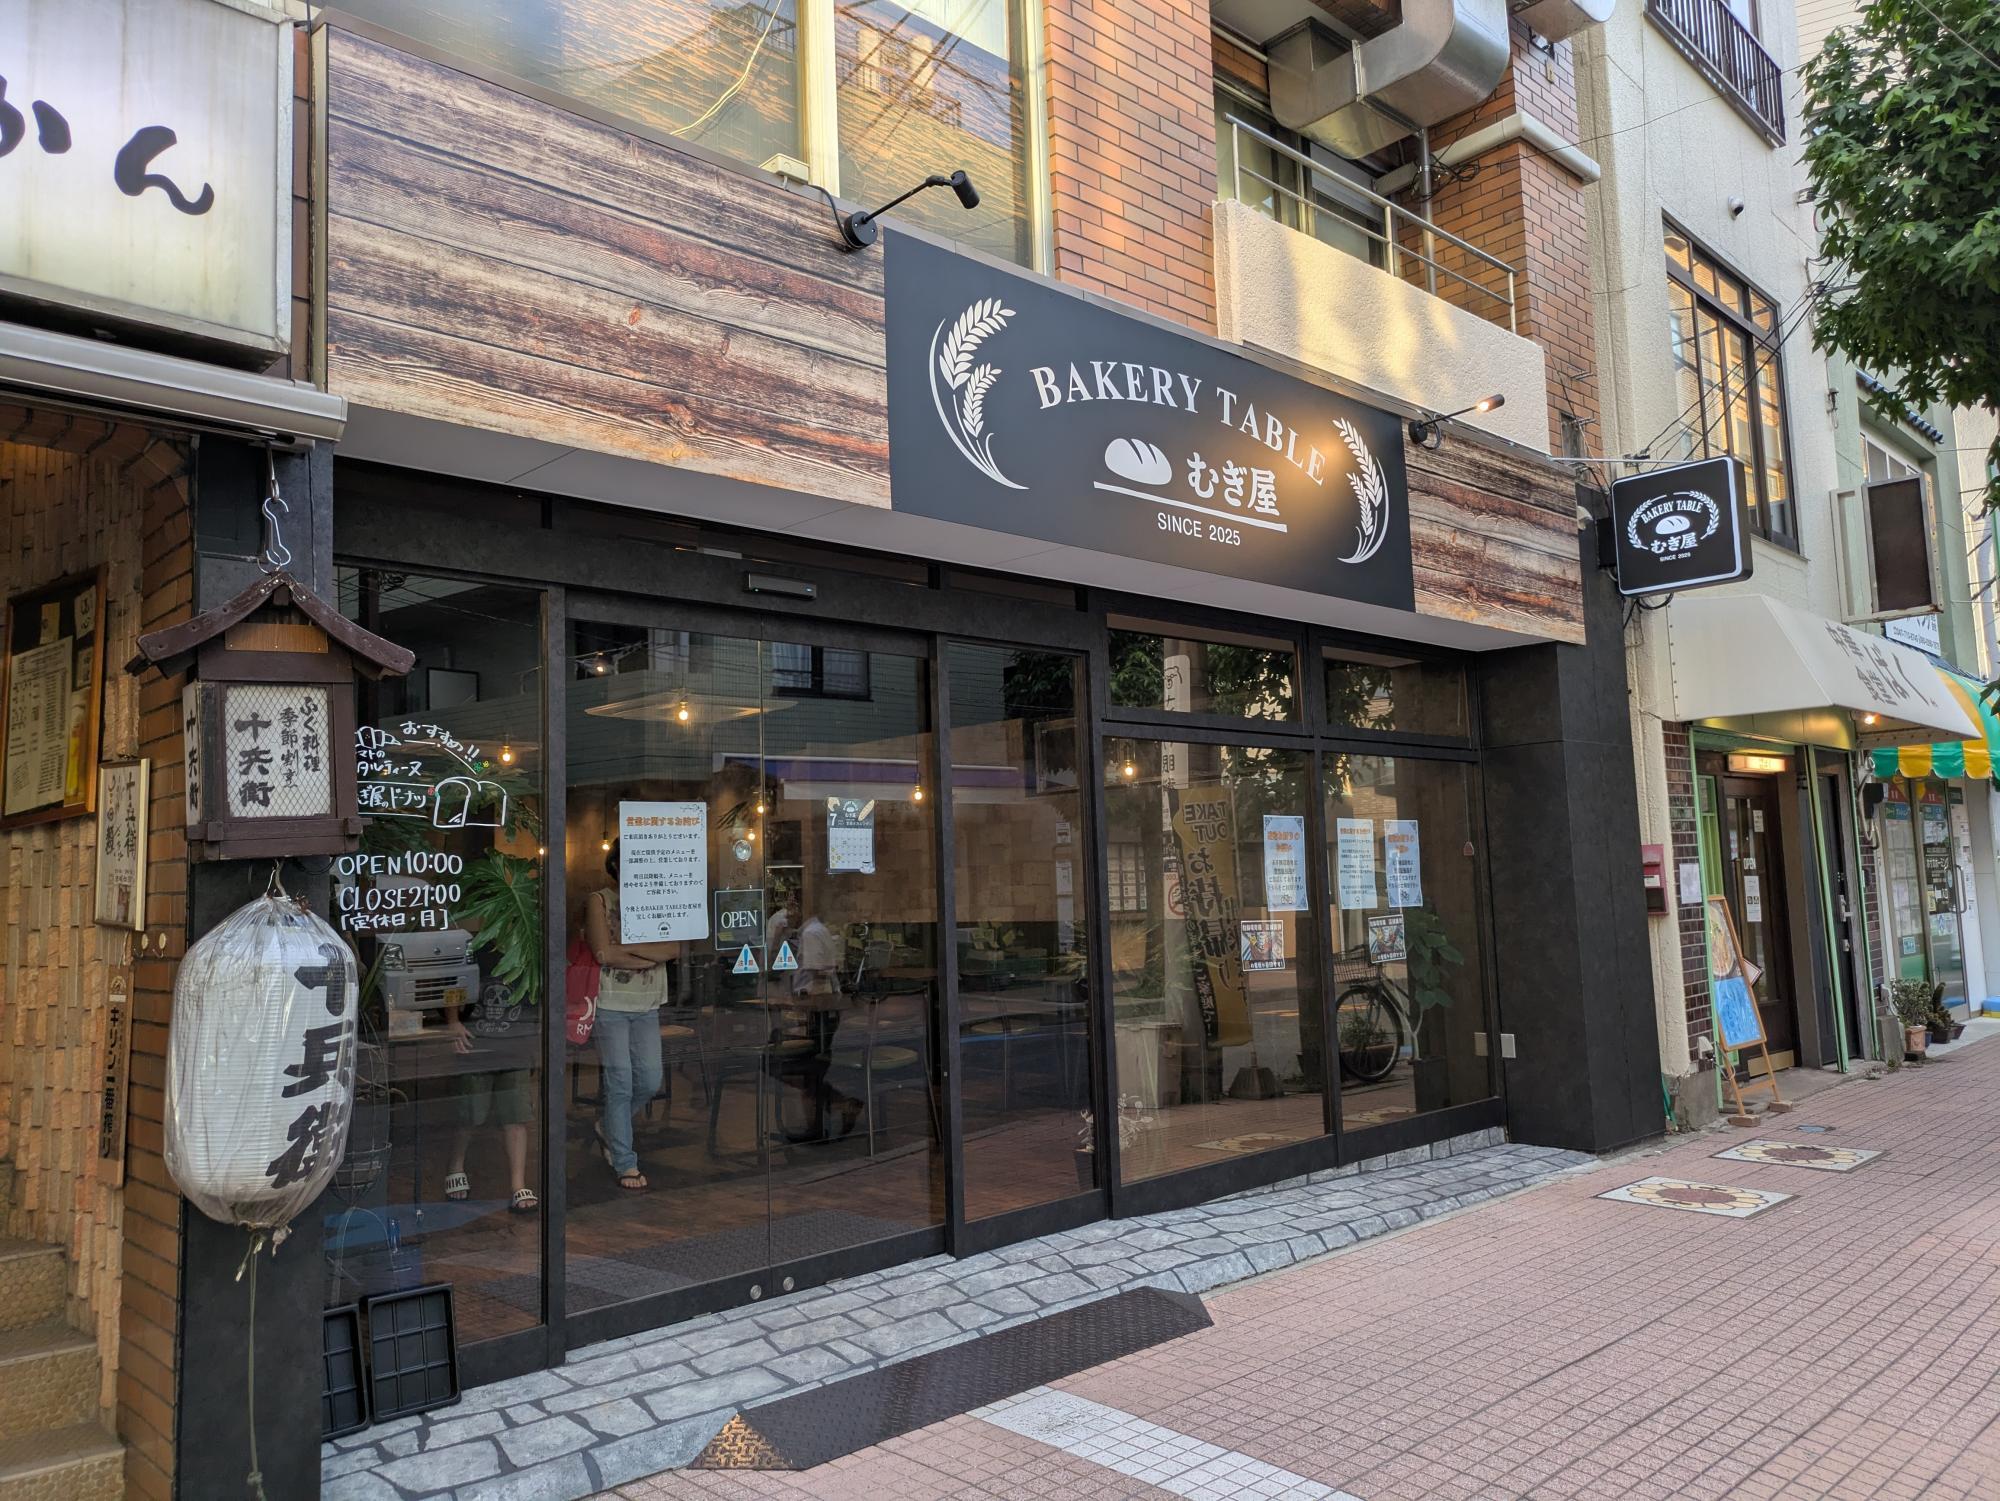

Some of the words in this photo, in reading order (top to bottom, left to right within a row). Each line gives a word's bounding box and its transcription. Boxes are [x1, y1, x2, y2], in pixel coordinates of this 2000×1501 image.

[1030, 361, 1202, 413] BAKERY
[1216, 388, 1325, 485] TABLE
[1187, 451, 1280, 515] むぎ屋
[1641, 501, 1674, 523] BAKERY
[1676, 500, 1703, 513] TABLE
[1157, 513, 1203, 539] SINCE
[1209, 524, 1241, 546] 2025
[1651, 532, 1698, 553] むぎ屋
[1660, 554, 1676, 562] SINCE
[300, 696, 320, 772] ふぐ料理
[234, 712, 275, 807] 十兵衛
[279, 707, 299, 788] 季節割烹
[829, 813, 837, 826] 7
[338, 854, 400, 875] OPEN
[404, 851, 463, 874] 10:00
[1744, 858, 1756, 869] OPEN
[340, 887, 408, 911] CLOSE
[409, 884, 461, 908] 21:00
[721, 910, 758, 928] OPEN
